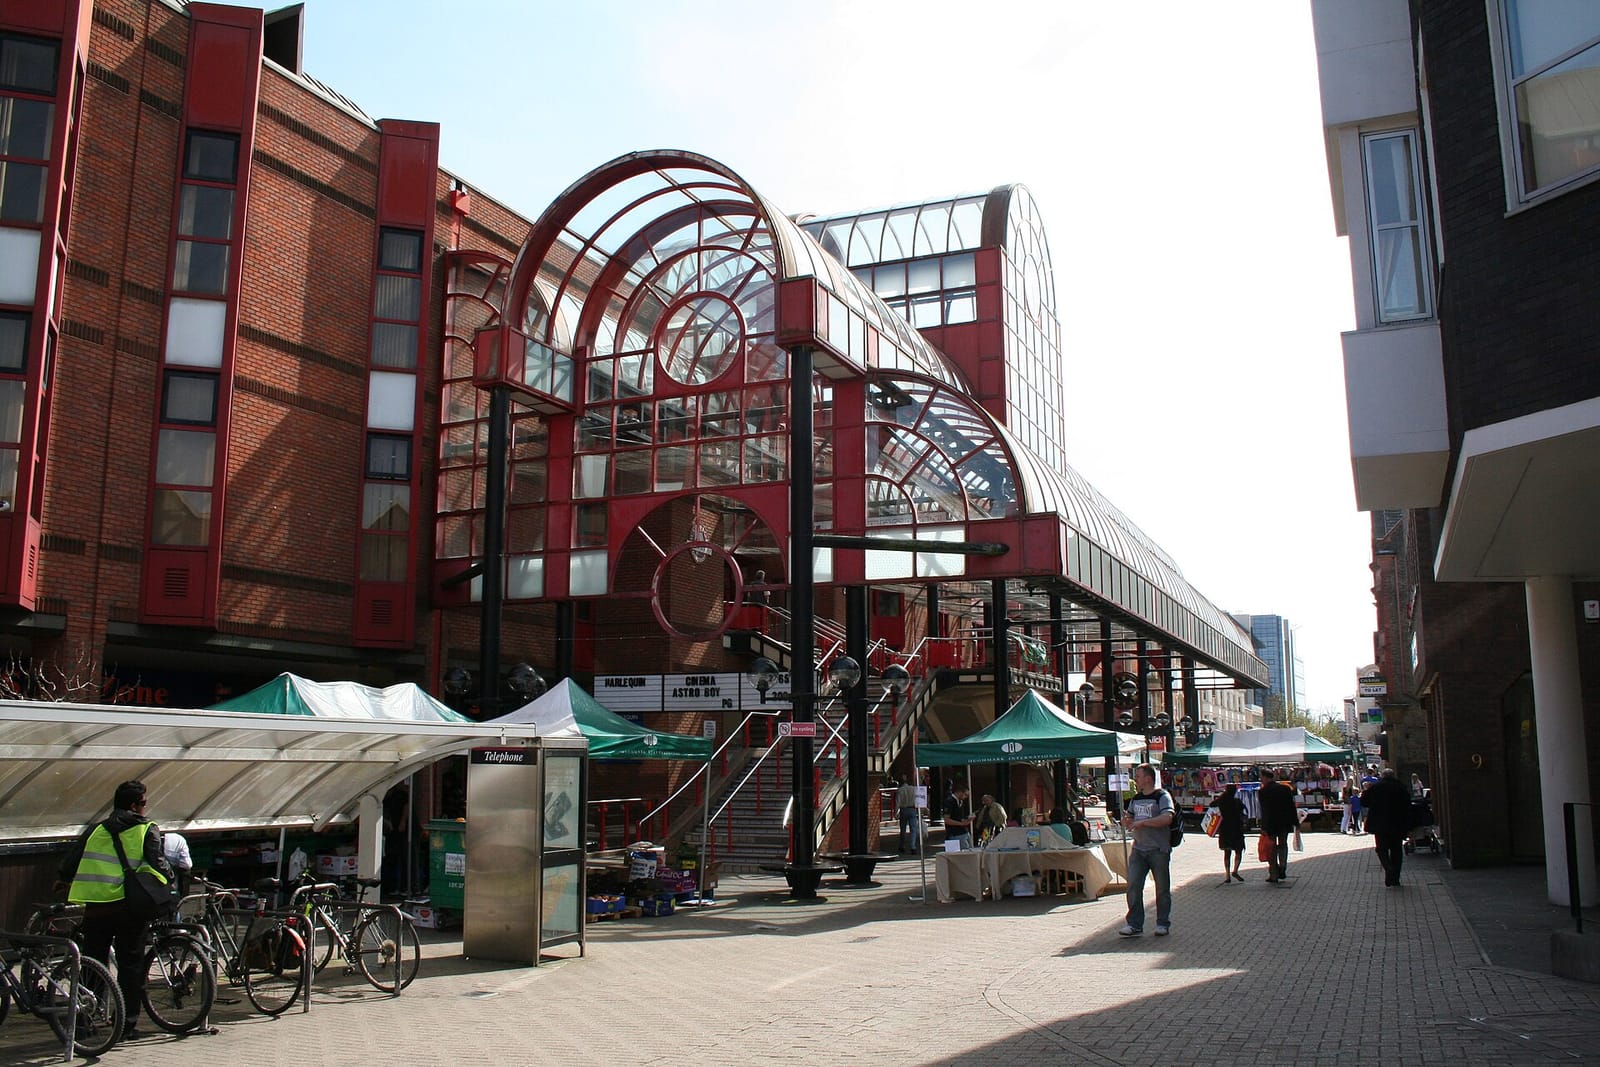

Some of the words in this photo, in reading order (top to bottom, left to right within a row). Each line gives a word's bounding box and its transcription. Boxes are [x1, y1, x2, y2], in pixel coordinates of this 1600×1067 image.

[604, 677, 647, 688] HARLEQUIN
[685, 676, 717, 686] CINEMA
[672, 687, 700, 698] ASTRO
[704, 687, 721, 698] BOY
[721, 698, 733, 709] PG
[484, 751, 524, 764] Telephone
[1471, 754, 1482, 770] 9
